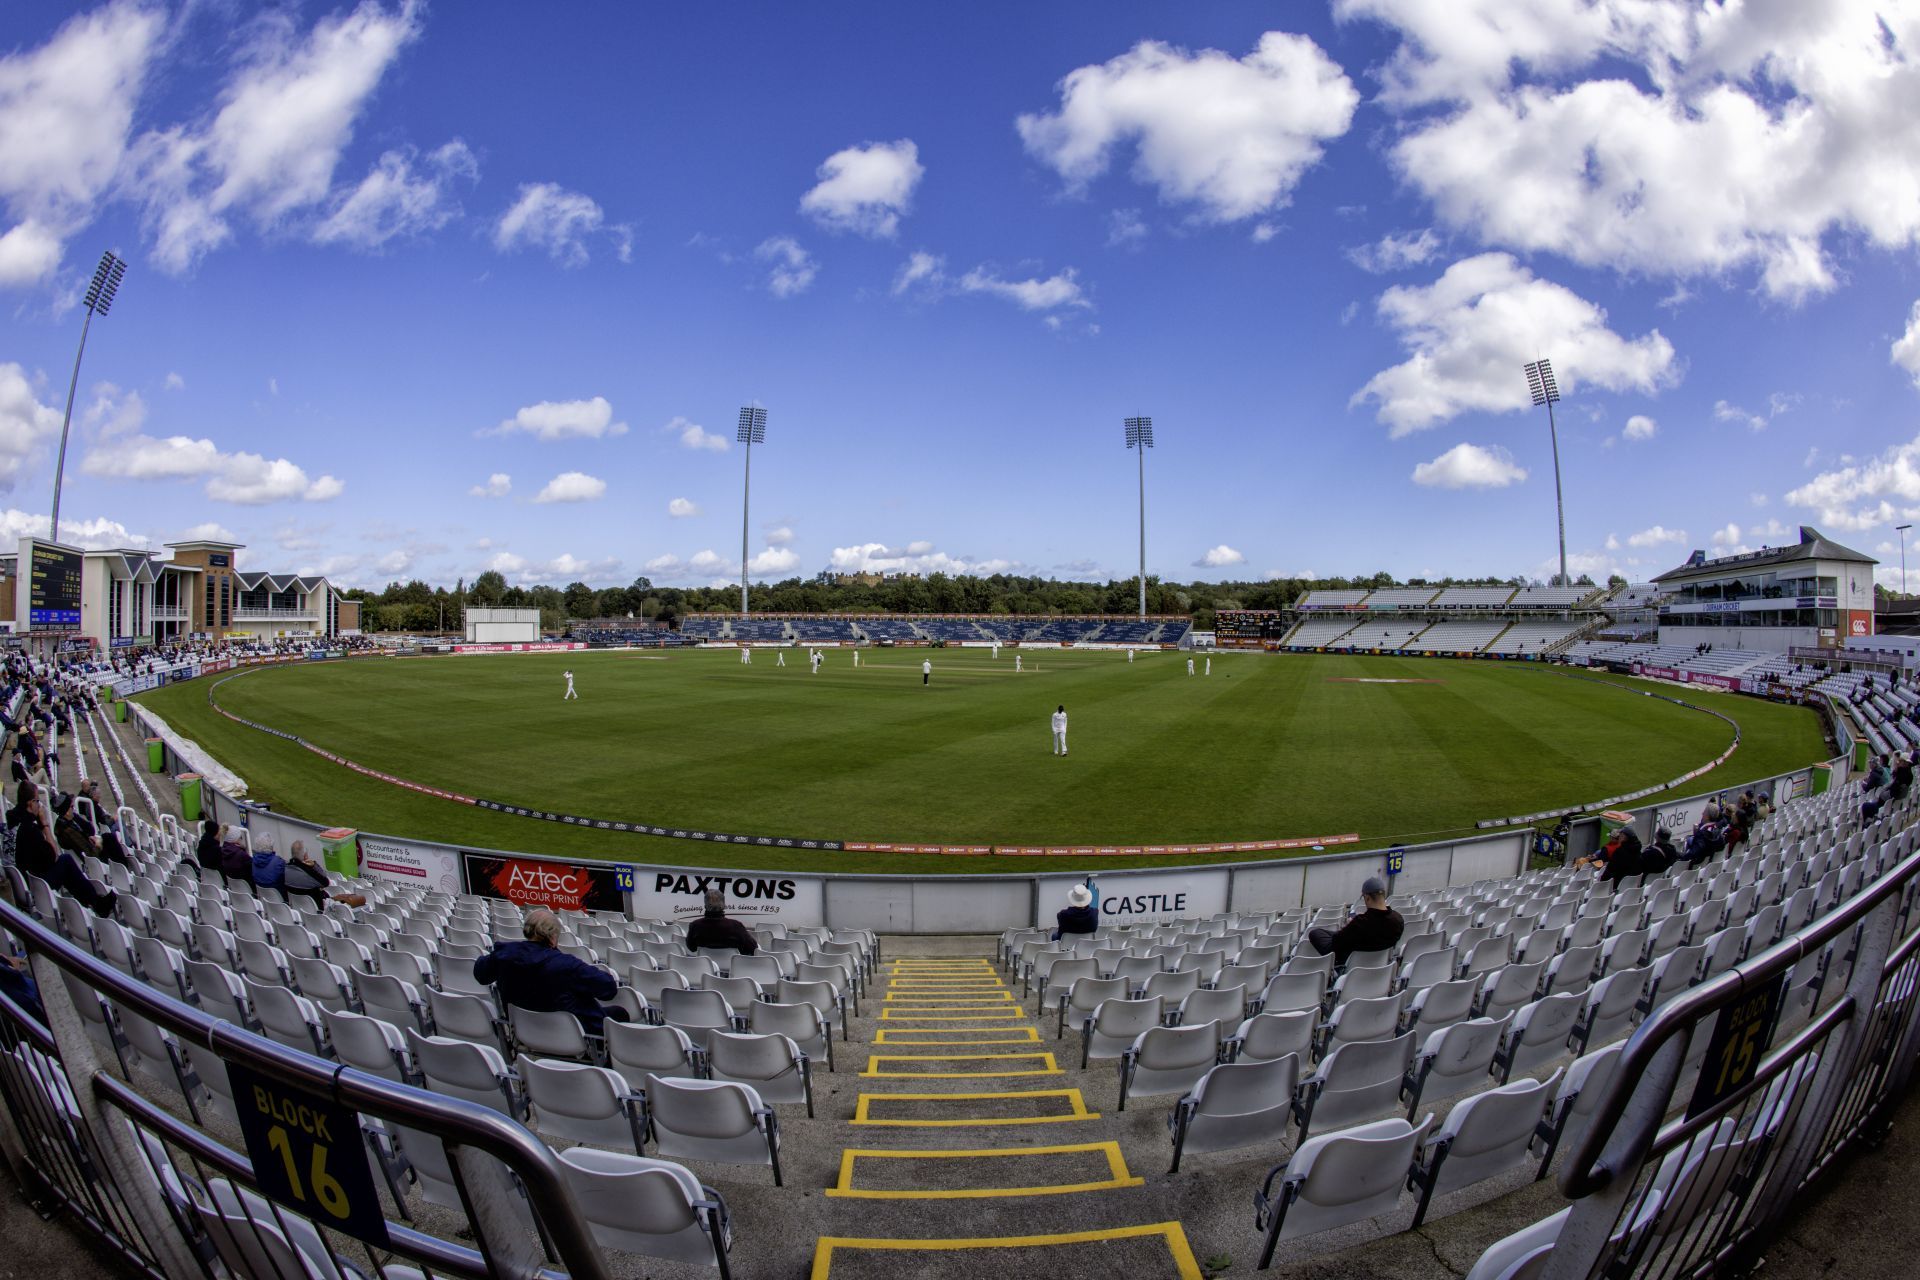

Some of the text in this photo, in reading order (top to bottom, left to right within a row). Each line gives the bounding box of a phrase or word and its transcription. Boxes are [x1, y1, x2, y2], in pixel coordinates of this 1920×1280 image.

[366, 842, 404, 855] Accountants
[367, 850, 420, 866] Business Advisors
[1390, 858, 1402, 870] 15
[508, 864, 578, 894] Aztec
[617, 874, 632, 888] 16
[655, 873, 796, 900] PAXTONS
[509, 888, 580, 905] COLOUR PRINT
[1102, 893, 1186, 916] CASTLE
[674, 904, 703, 914] Serving
[760, 904, 780, 914] 1853
[1714, 1020, 1762, 1095] 15
[253, 1084, 334, 1143] BLOCK
[267, 1125, 350, 1220] 16
